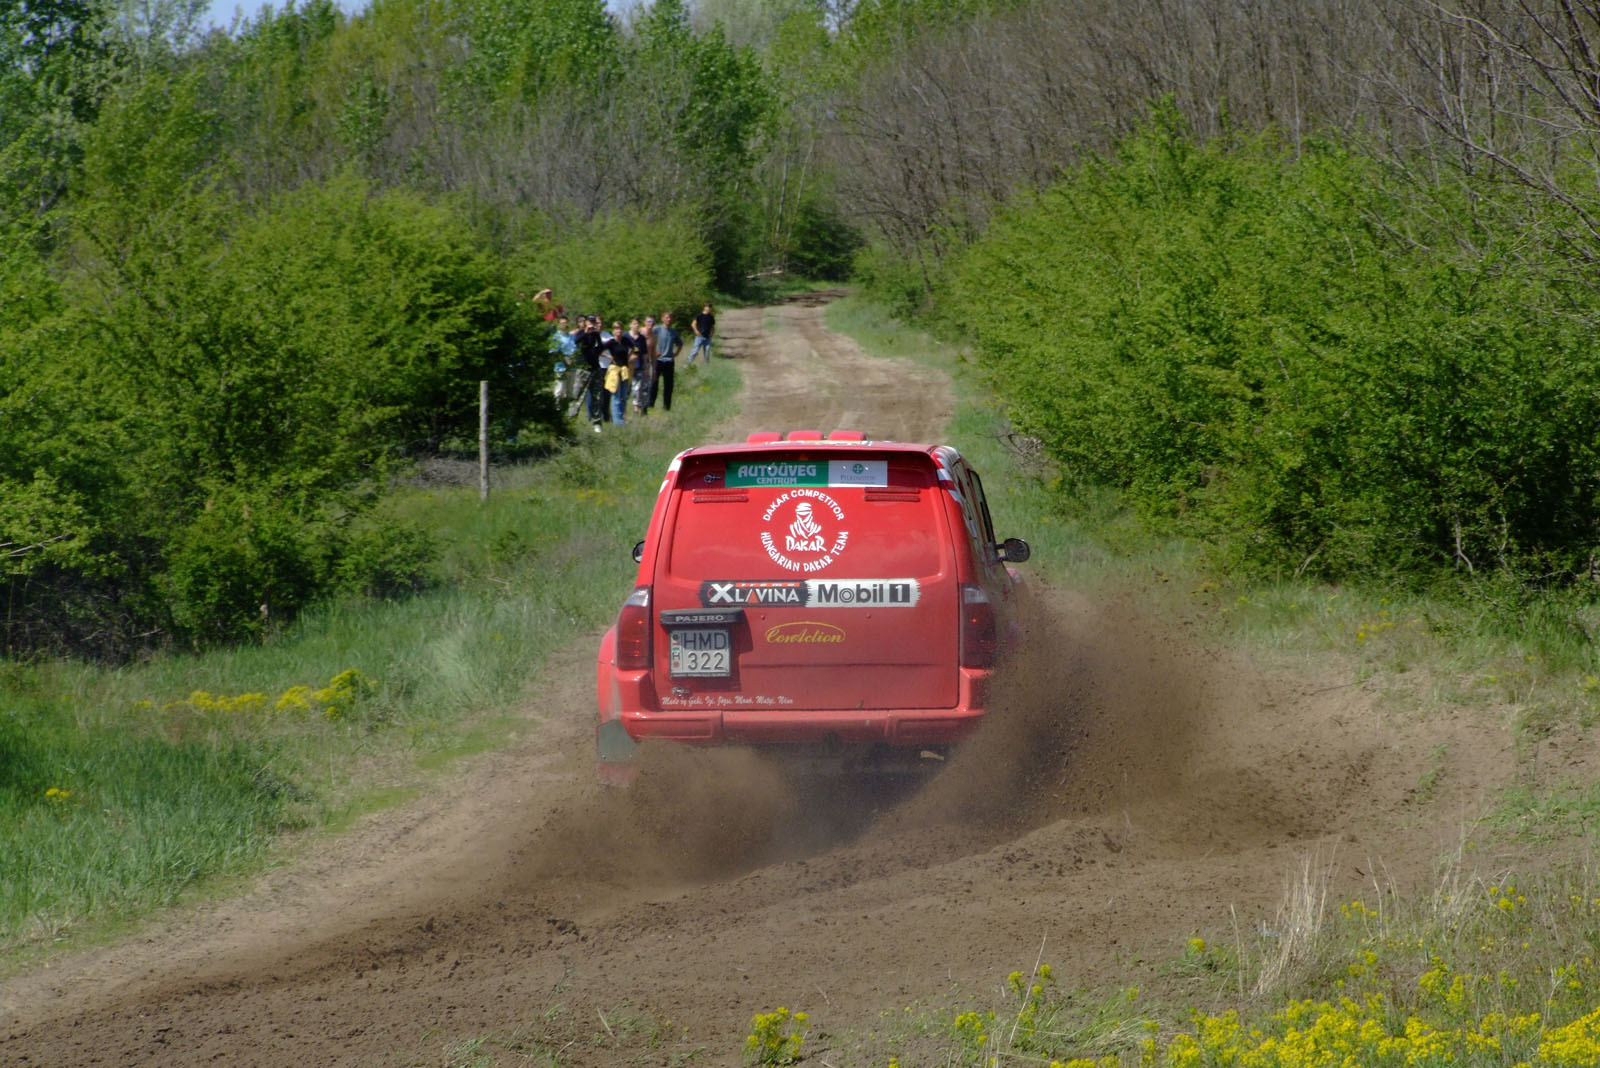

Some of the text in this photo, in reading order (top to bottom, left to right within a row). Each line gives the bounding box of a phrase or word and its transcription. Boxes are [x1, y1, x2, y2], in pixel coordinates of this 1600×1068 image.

[738, 462, 817, 478] AUTÓÜVEG
[756, 477, 797, 485] CENTRUM
[762, 489, 845, 521] DAKAR COMPETITOR
[760, 531, 849, 572] HUNGARIAN DAKAR TEAM
[785, 535, 827, 552] DAKAR
[818, 583, 884, 603] Mobil
[684, 632, 727, 650] HMD
[688, 652, 724, 670] 322
